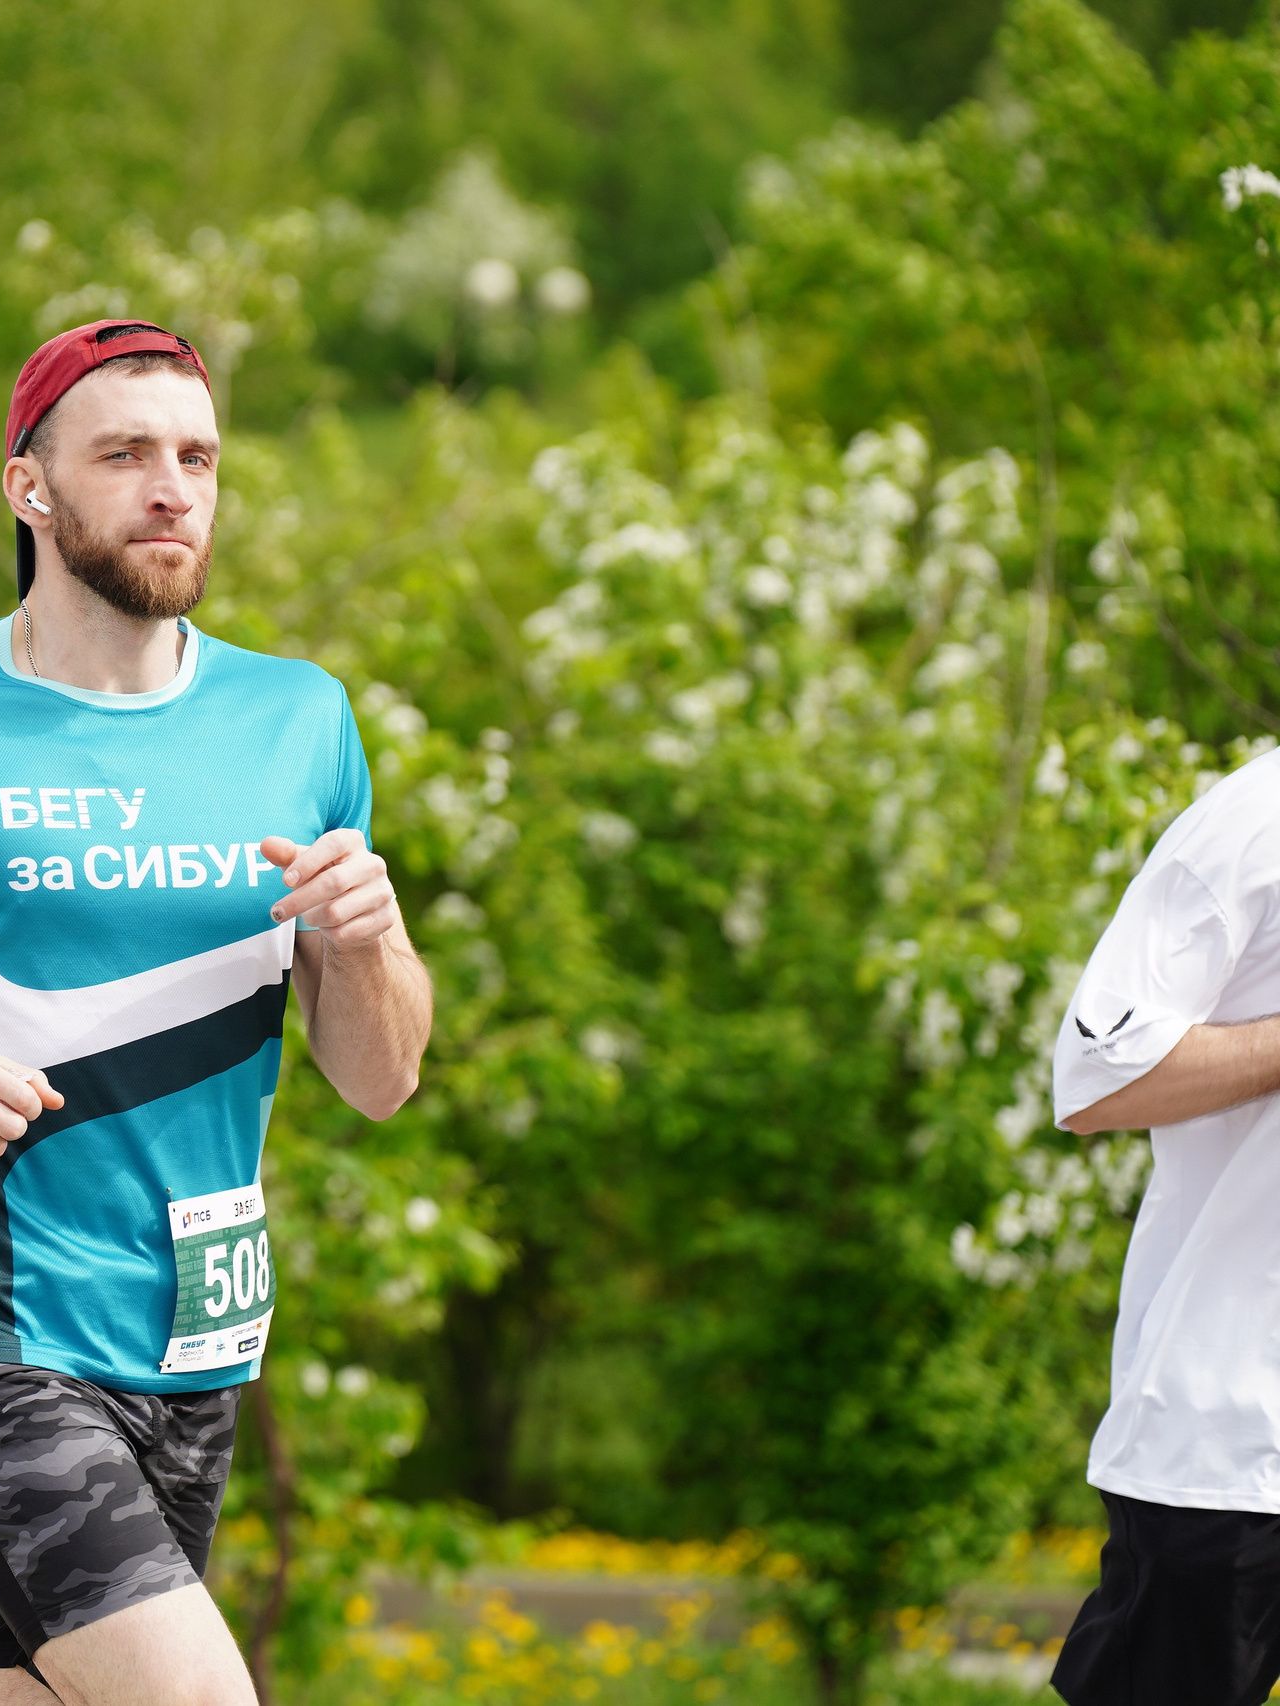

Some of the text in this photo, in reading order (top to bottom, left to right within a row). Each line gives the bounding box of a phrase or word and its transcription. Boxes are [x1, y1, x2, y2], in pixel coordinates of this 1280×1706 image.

[7, 842, 277, 891] за СИБУР
[194, 1210, 211, 1223] ПСБ
[204, 1229, 270, 1318] 508
[180, 1339, 206, 1349] СИБУР
